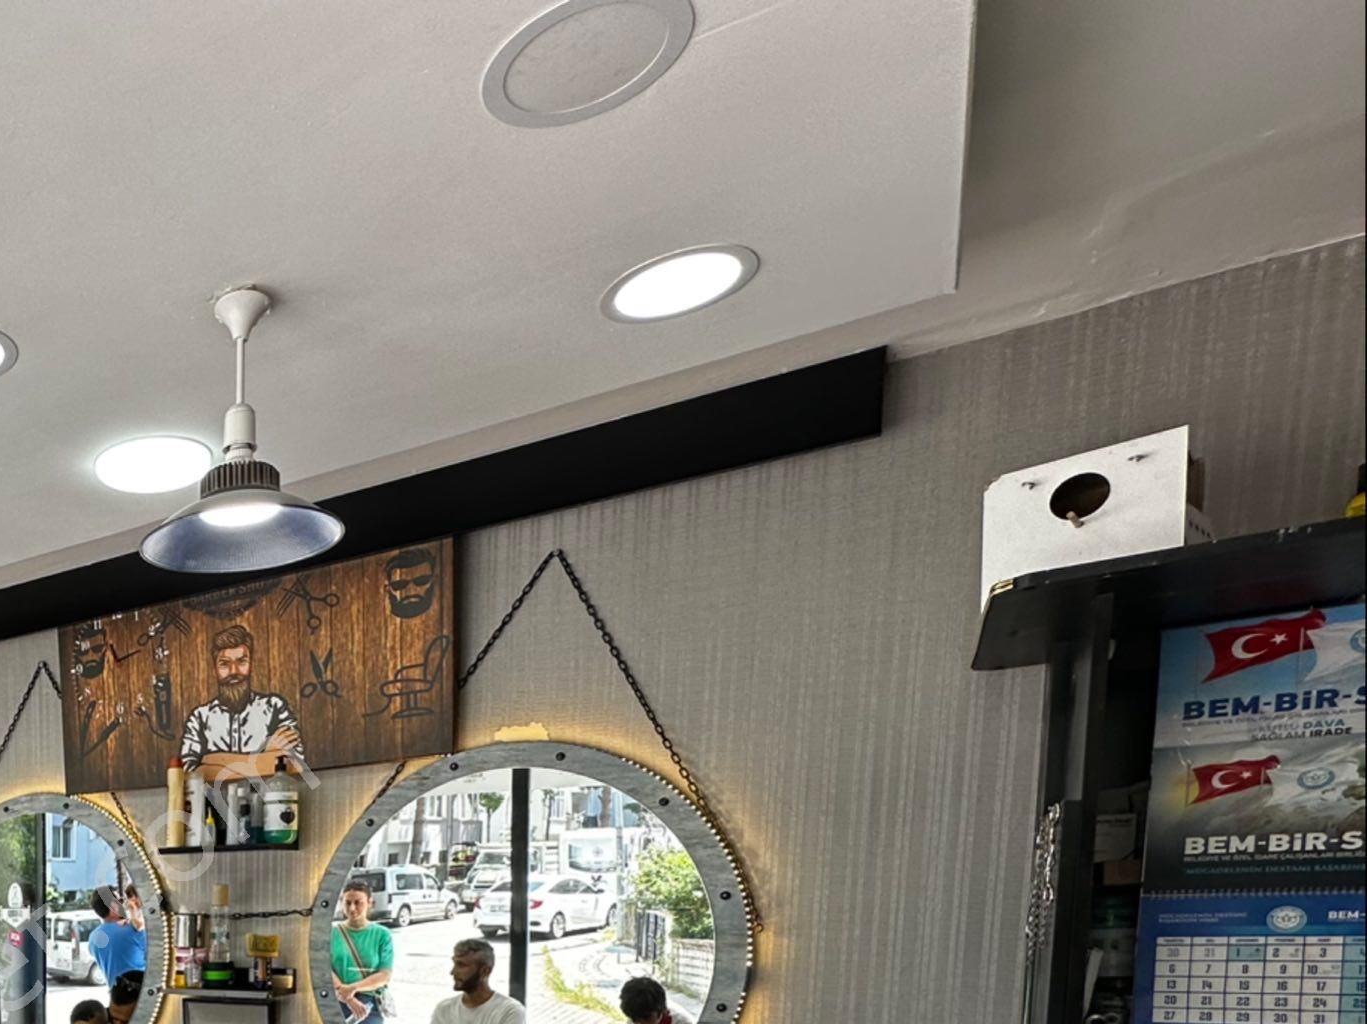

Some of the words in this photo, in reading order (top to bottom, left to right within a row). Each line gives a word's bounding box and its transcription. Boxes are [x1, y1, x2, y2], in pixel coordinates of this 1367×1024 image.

[1302, 719, 1345, 731] DAVA
[1169, 964, 1176, 974] 6
[1205, 964, 1211, 974] 7
[1307, 964, 1318, 974] 10
[1166, 980, 1176, 990] 13
[1201, 980, 1212, 990] 14
[1277, 980, 1288, 991] 16
[1316, 981, 1326, 992] 17
[1164, 995, 1177, 1005] 20
[1200, 996, 1212, 1006] 21
[1236, 997, 1250, 1007] 22
[1274, 997, 1288, 1008] 23
[1313, 998, 1326, 1009] 24
[1163, 1011, 1176, 1021] 27
[1199, 1012, 1212, 1022] 28
[1236, 1012, 1250, 1022] 29
[1274, 1013, 1287, 1024] 30
[1313, 1014, 1325, 1024] 31
